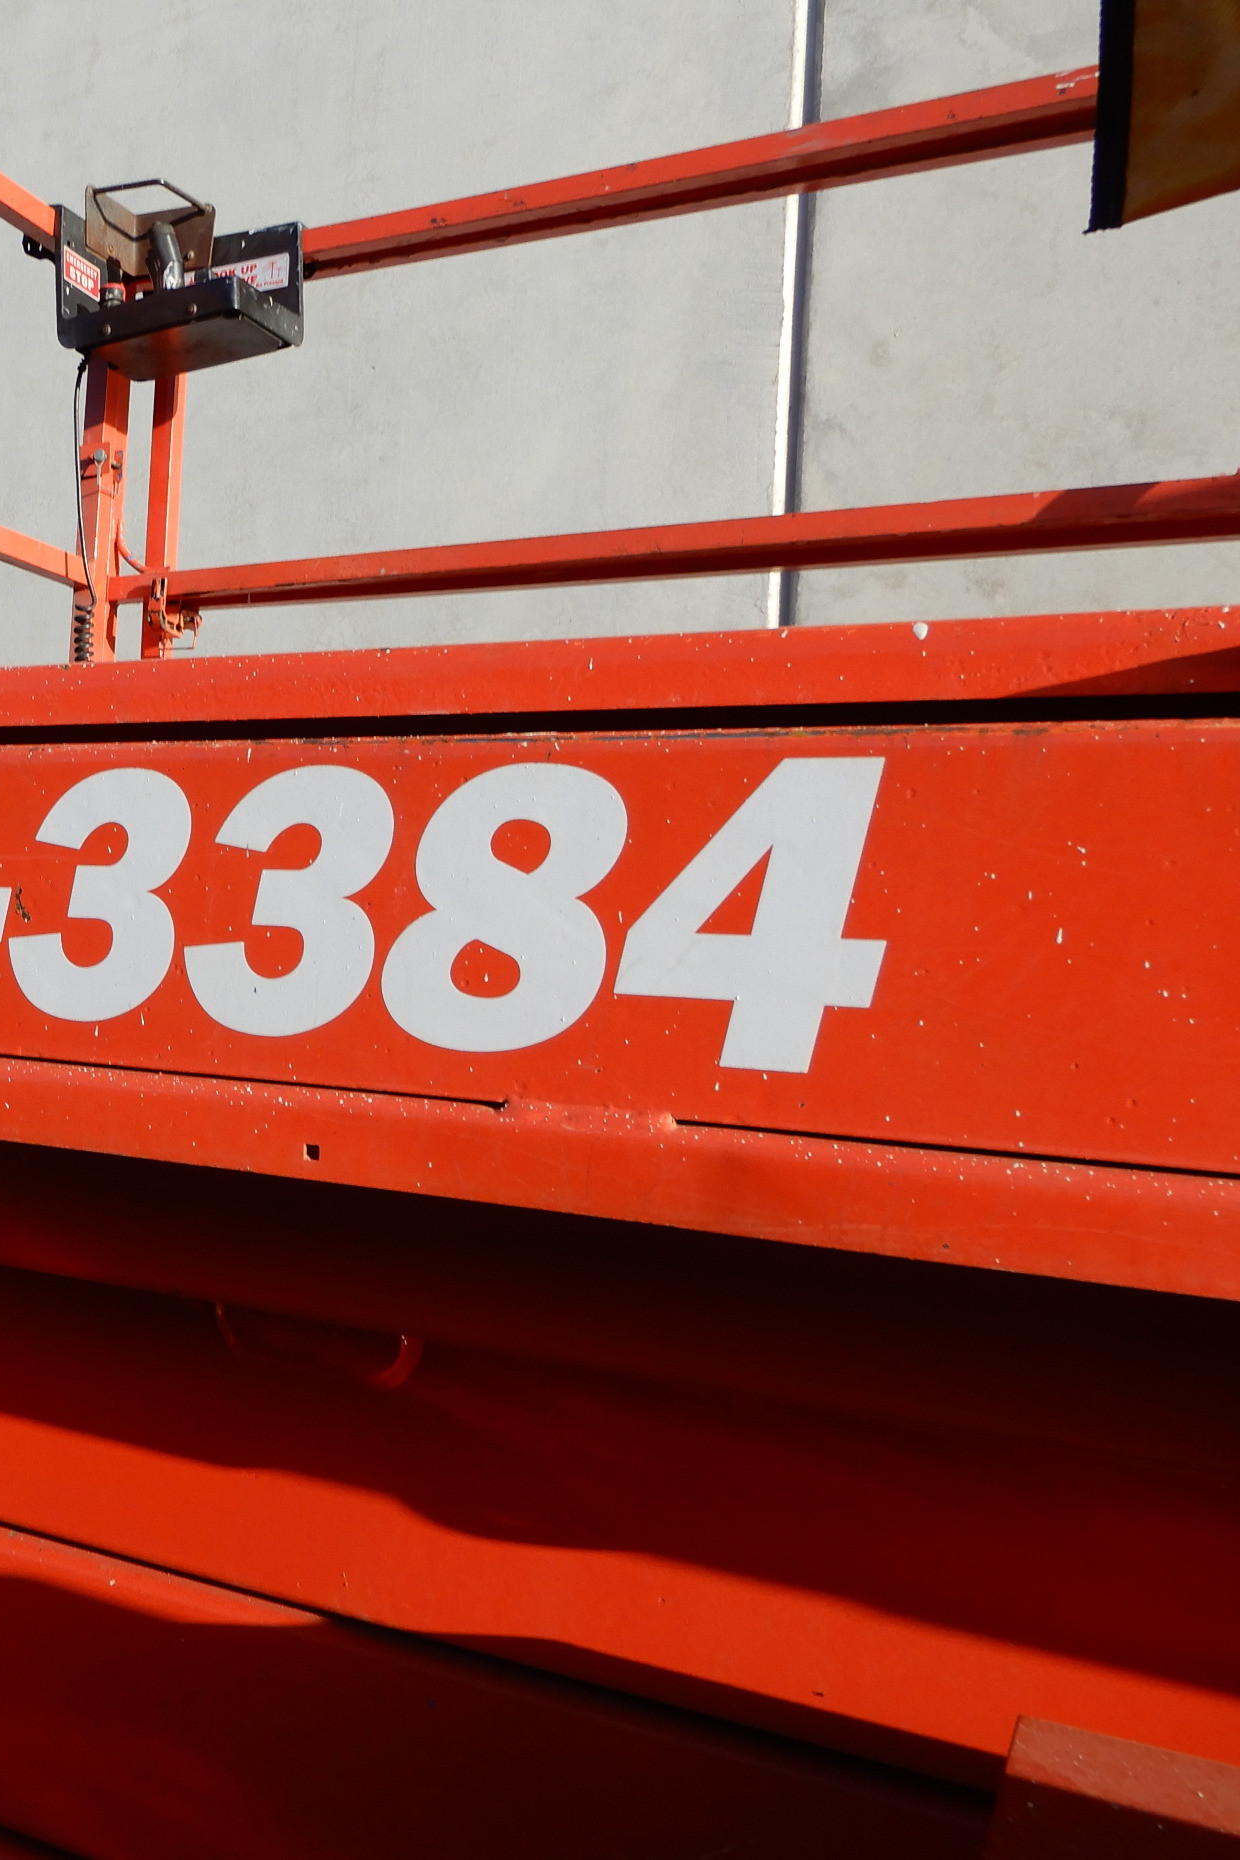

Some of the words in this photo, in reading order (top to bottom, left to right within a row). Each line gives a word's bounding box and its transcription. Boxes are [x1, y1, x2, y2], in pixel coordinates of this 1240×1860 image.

[66, 251, 98, 281] EMERGENCY
[69, 264, 95, 292] STOP
[240, 263, 258, 275] UP
